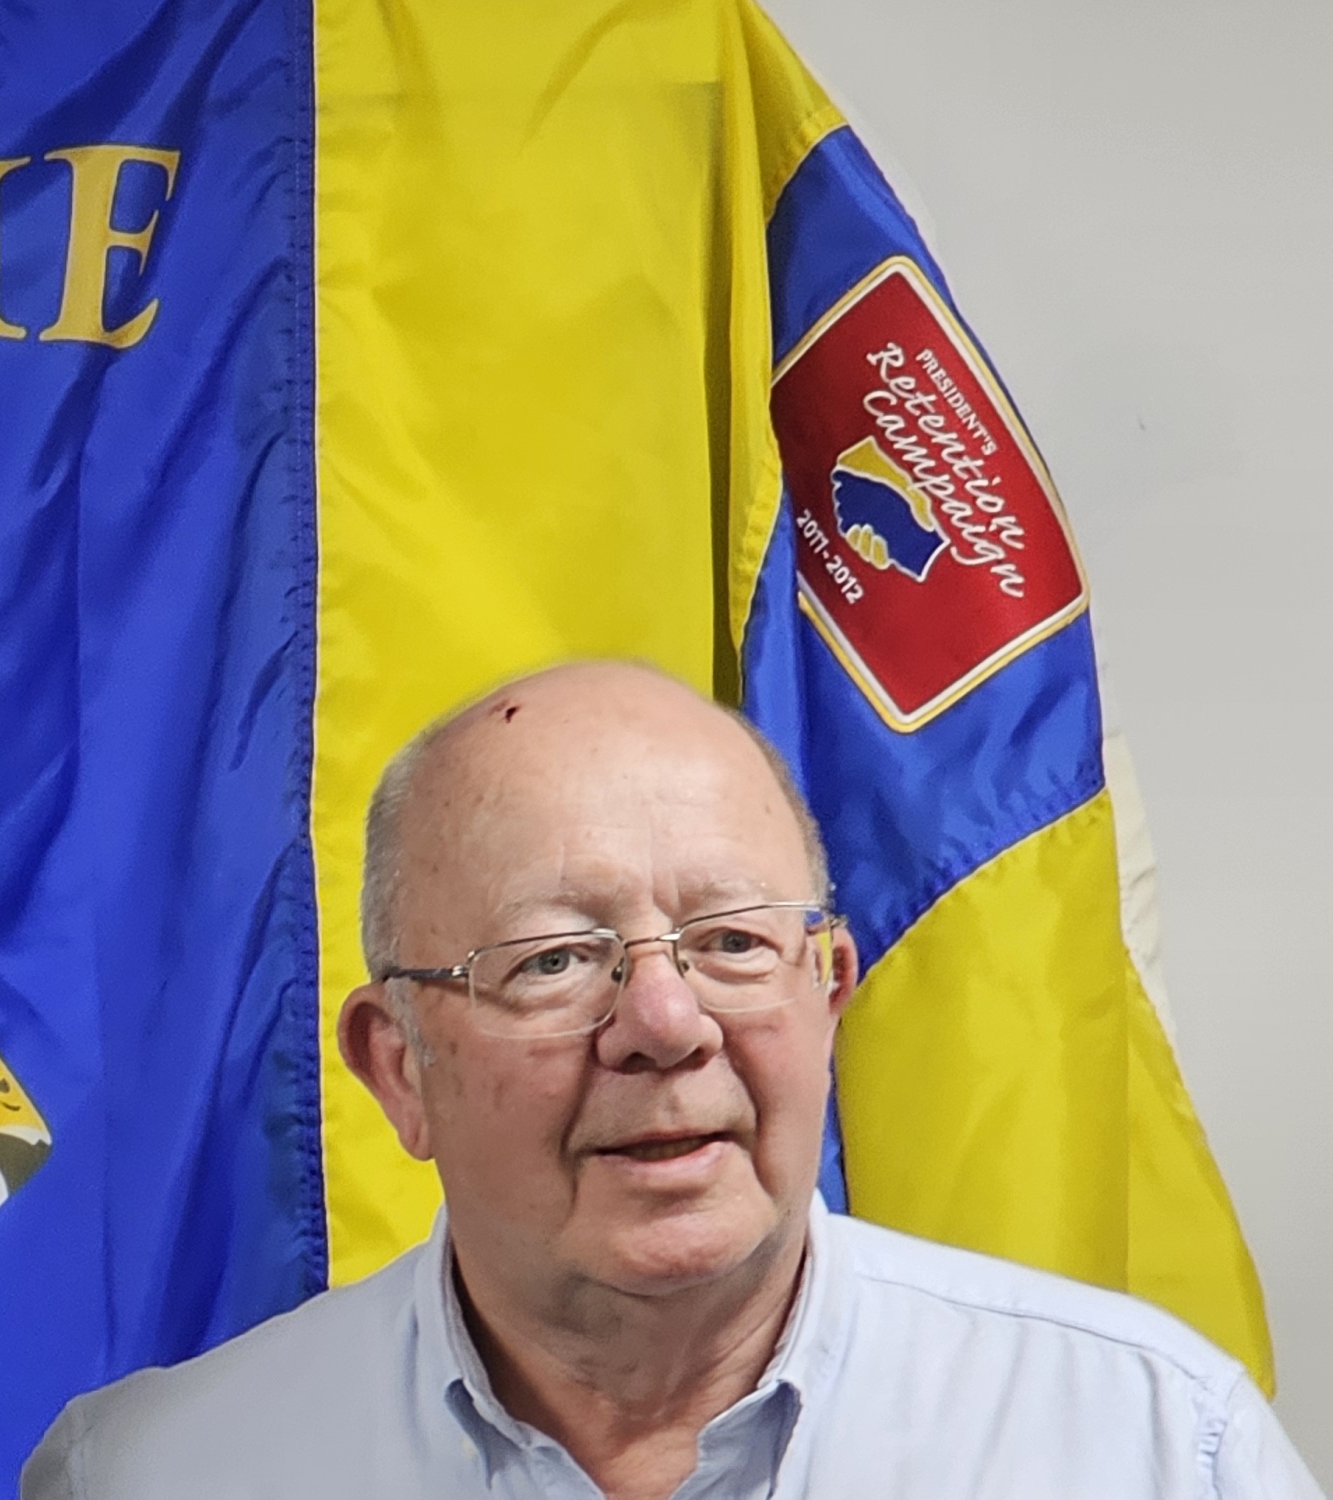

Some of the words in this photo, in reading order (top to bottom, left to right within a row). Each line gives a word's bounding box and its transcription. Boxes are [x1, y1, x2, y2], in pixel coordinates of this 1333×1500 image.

[866, 342, 1026, 550] Retention
[915, 349, 997, 457] PRESIDENT'S
[795, 508, 865, 605] 2011-2012
[863, 390, 1026, 598] Campaign
